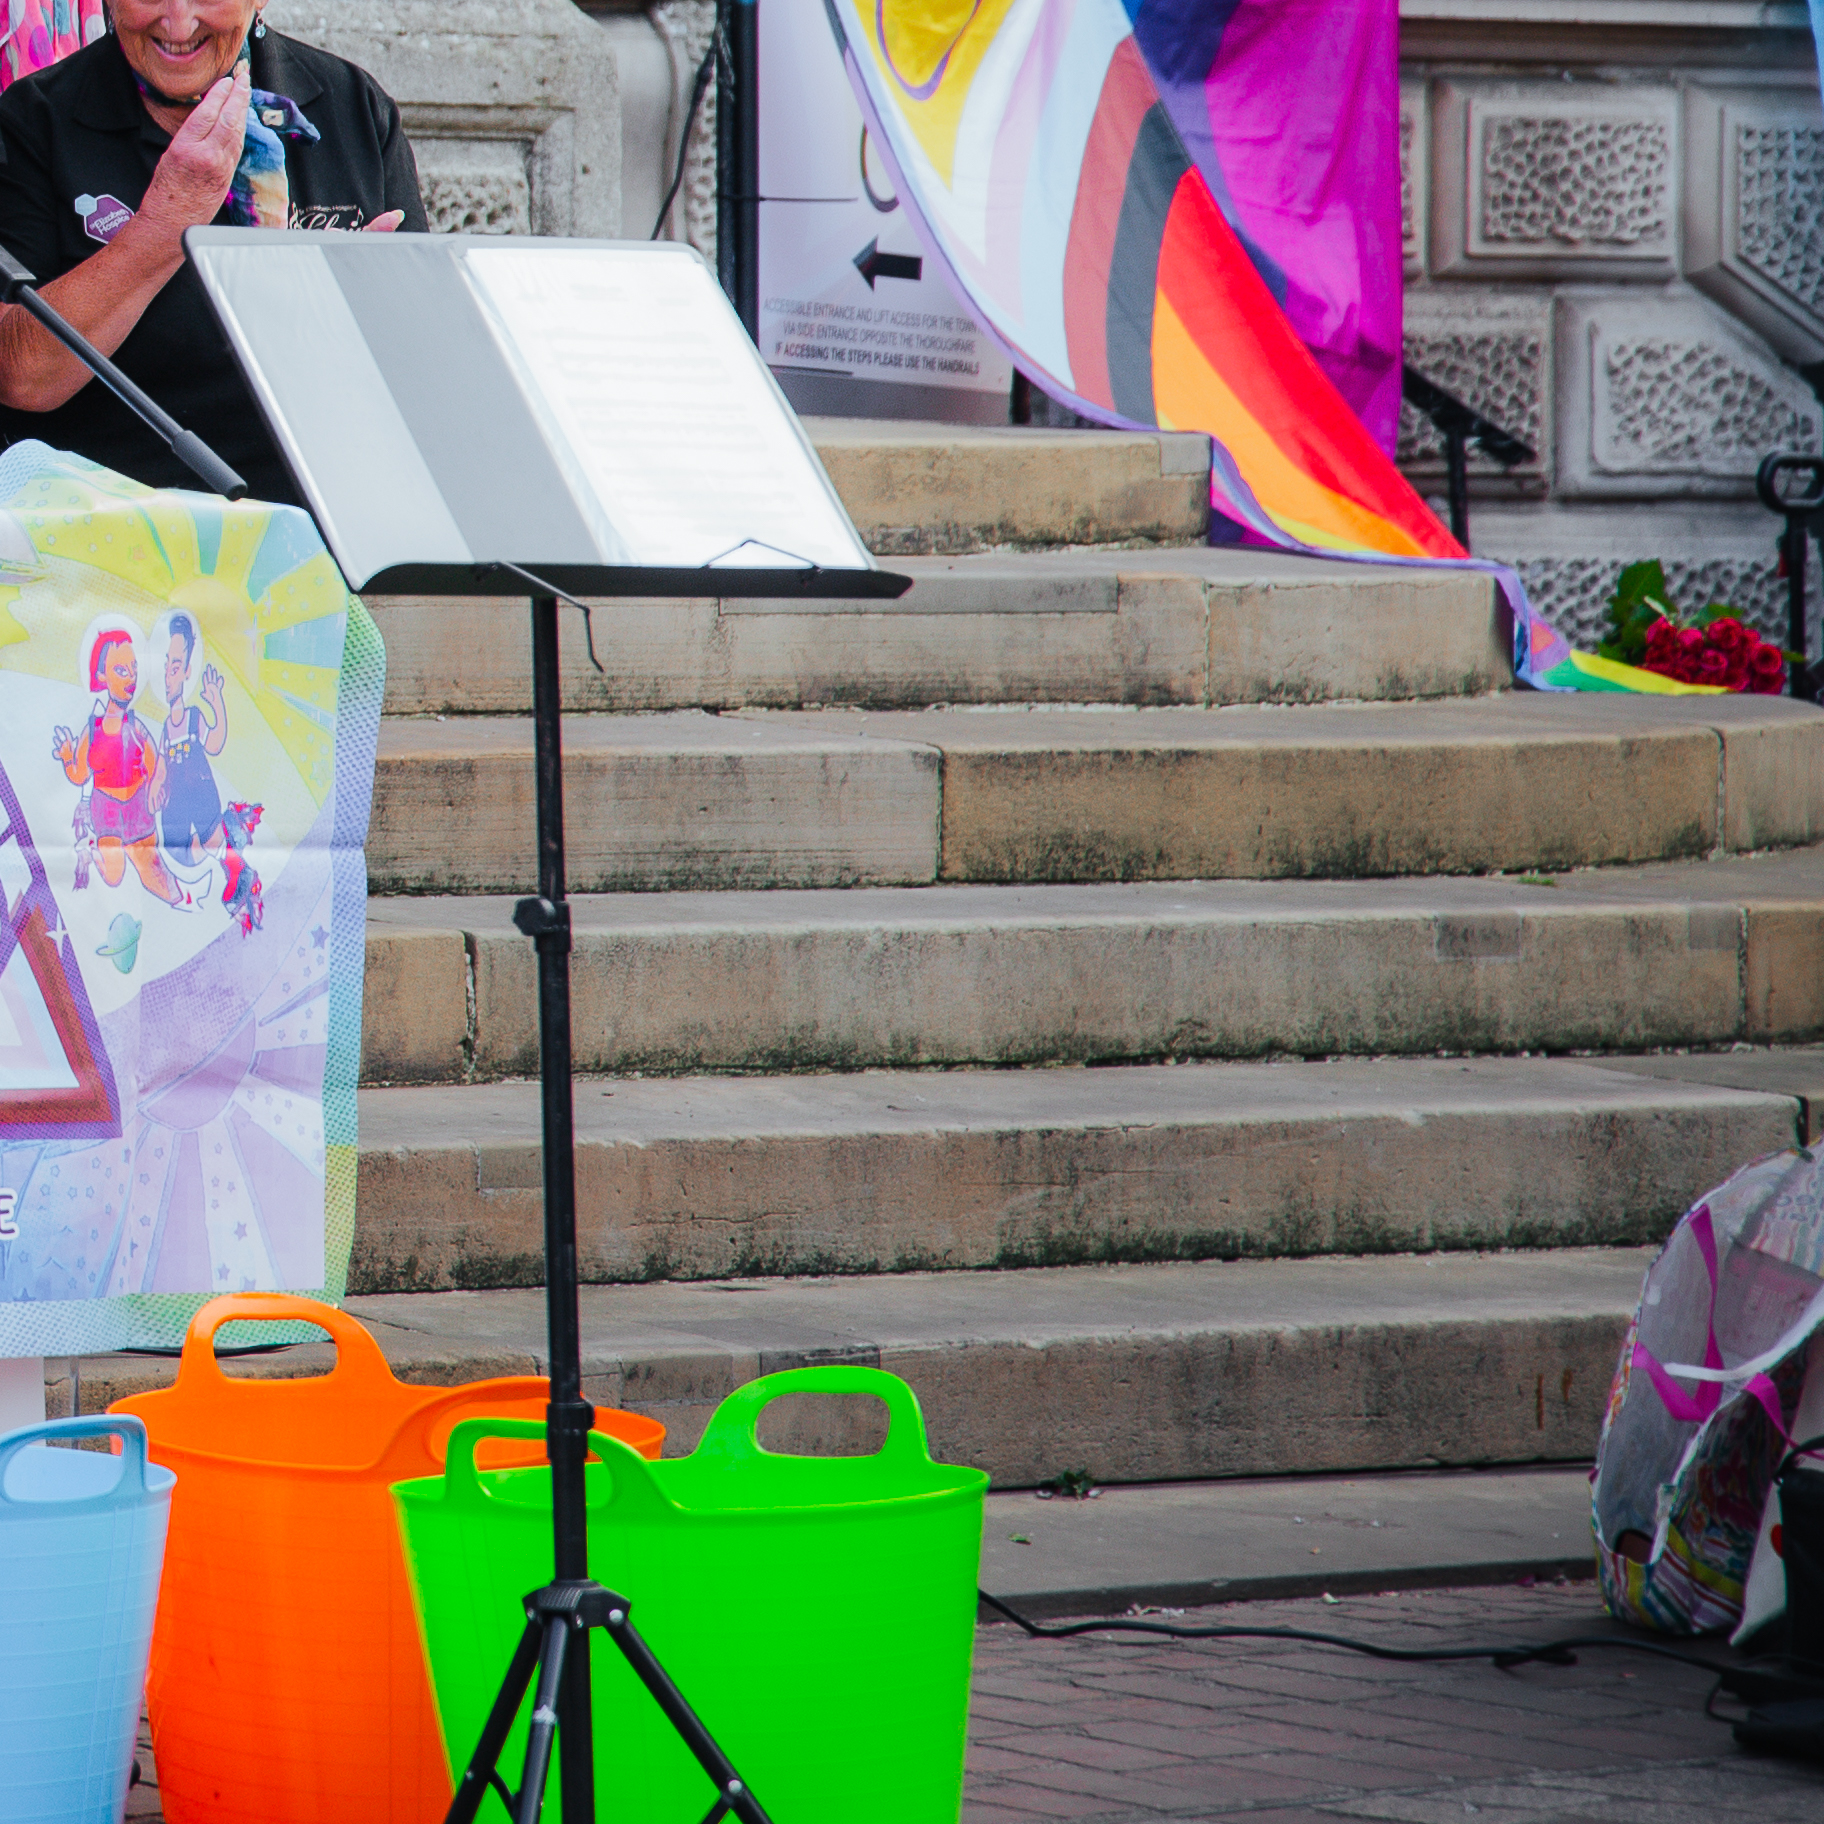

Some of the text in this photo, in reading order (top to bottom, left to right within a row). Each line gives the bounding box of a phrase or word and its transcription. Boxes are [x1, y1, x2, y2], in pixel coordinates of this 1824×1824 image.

[763, 297, 812, 316] ACCESSIBLE
[813, 302, 856, 320] ENTRANCE
[856, 307, 872, 322] AND
[890, 310, 921, 327] ACCESS
[922, 313, 938, 329] FOR
[939, 316, 953, 332] THE
[797, 321, 815, 337] SIDE
[816, 323, 858, 343] ENTRANCE
[859, 328, 898, 347] OPPOSITE
[899, 332, 913, 347] THE
[783, 342, 829, 361] ACCESSING
[831, 346, 846, 362] THE
[847, 348, 872, 364] STEPS
[873, 352, 903, 368] PLEASE
[904, 354, 920, 371] USE
[922, 355, 936, 372] THE
